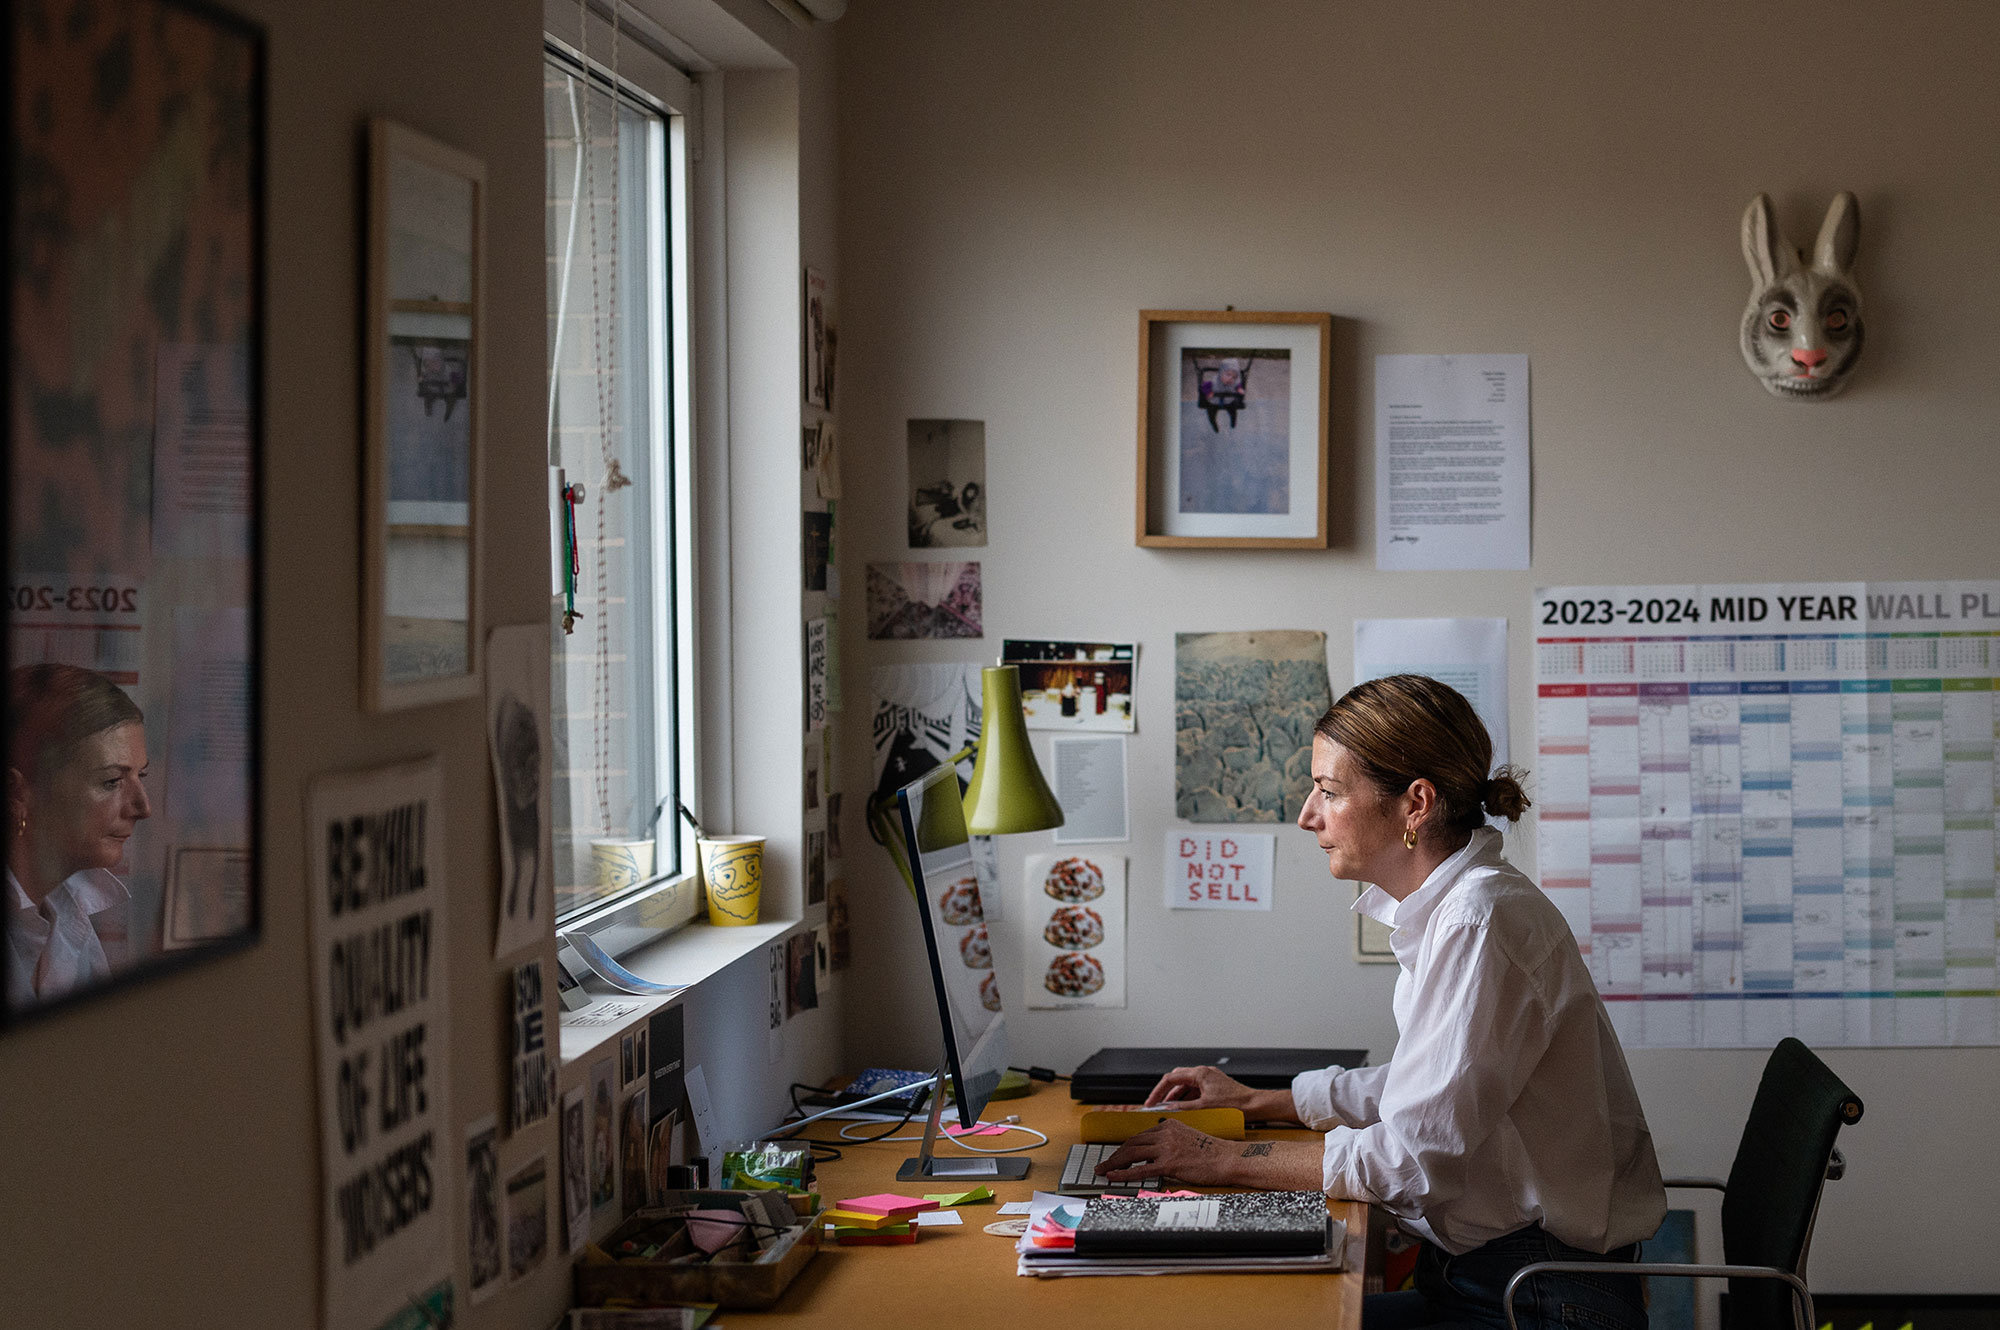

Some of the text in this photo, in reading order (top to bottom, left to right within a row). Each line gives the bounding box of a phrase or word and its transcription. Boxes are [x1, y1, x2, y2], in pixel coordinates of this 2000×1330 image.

[1542, 593, 2000, 625] 2023-2024 MID YEAR WALL PL
[1179, 838, 1239, 861] DID
[1187, 863, 1246, 881] NOT
[1188, 882, 1259, 902] SELL
